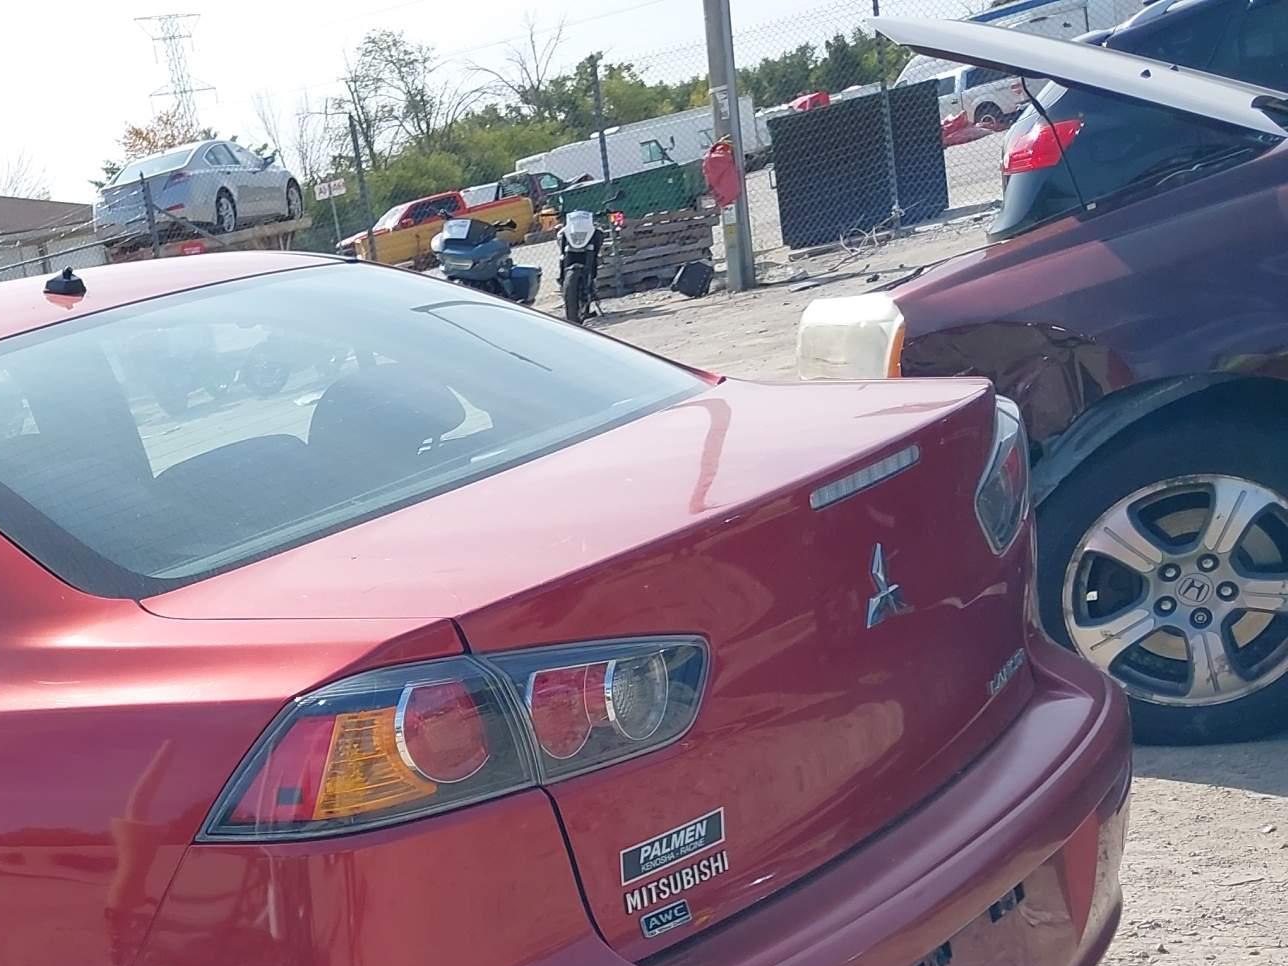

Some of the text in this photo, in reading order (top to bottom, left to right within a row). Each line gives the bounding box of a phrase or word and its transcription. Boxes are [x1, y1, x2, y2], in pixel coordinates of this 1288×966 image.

[640, 820, 707, 865] PALMEN
[641, 852, 675, 873] KENOSHA
[625, 851, 729, 914] MITSUBISHI
[649, 904, 687, 930] AWC
